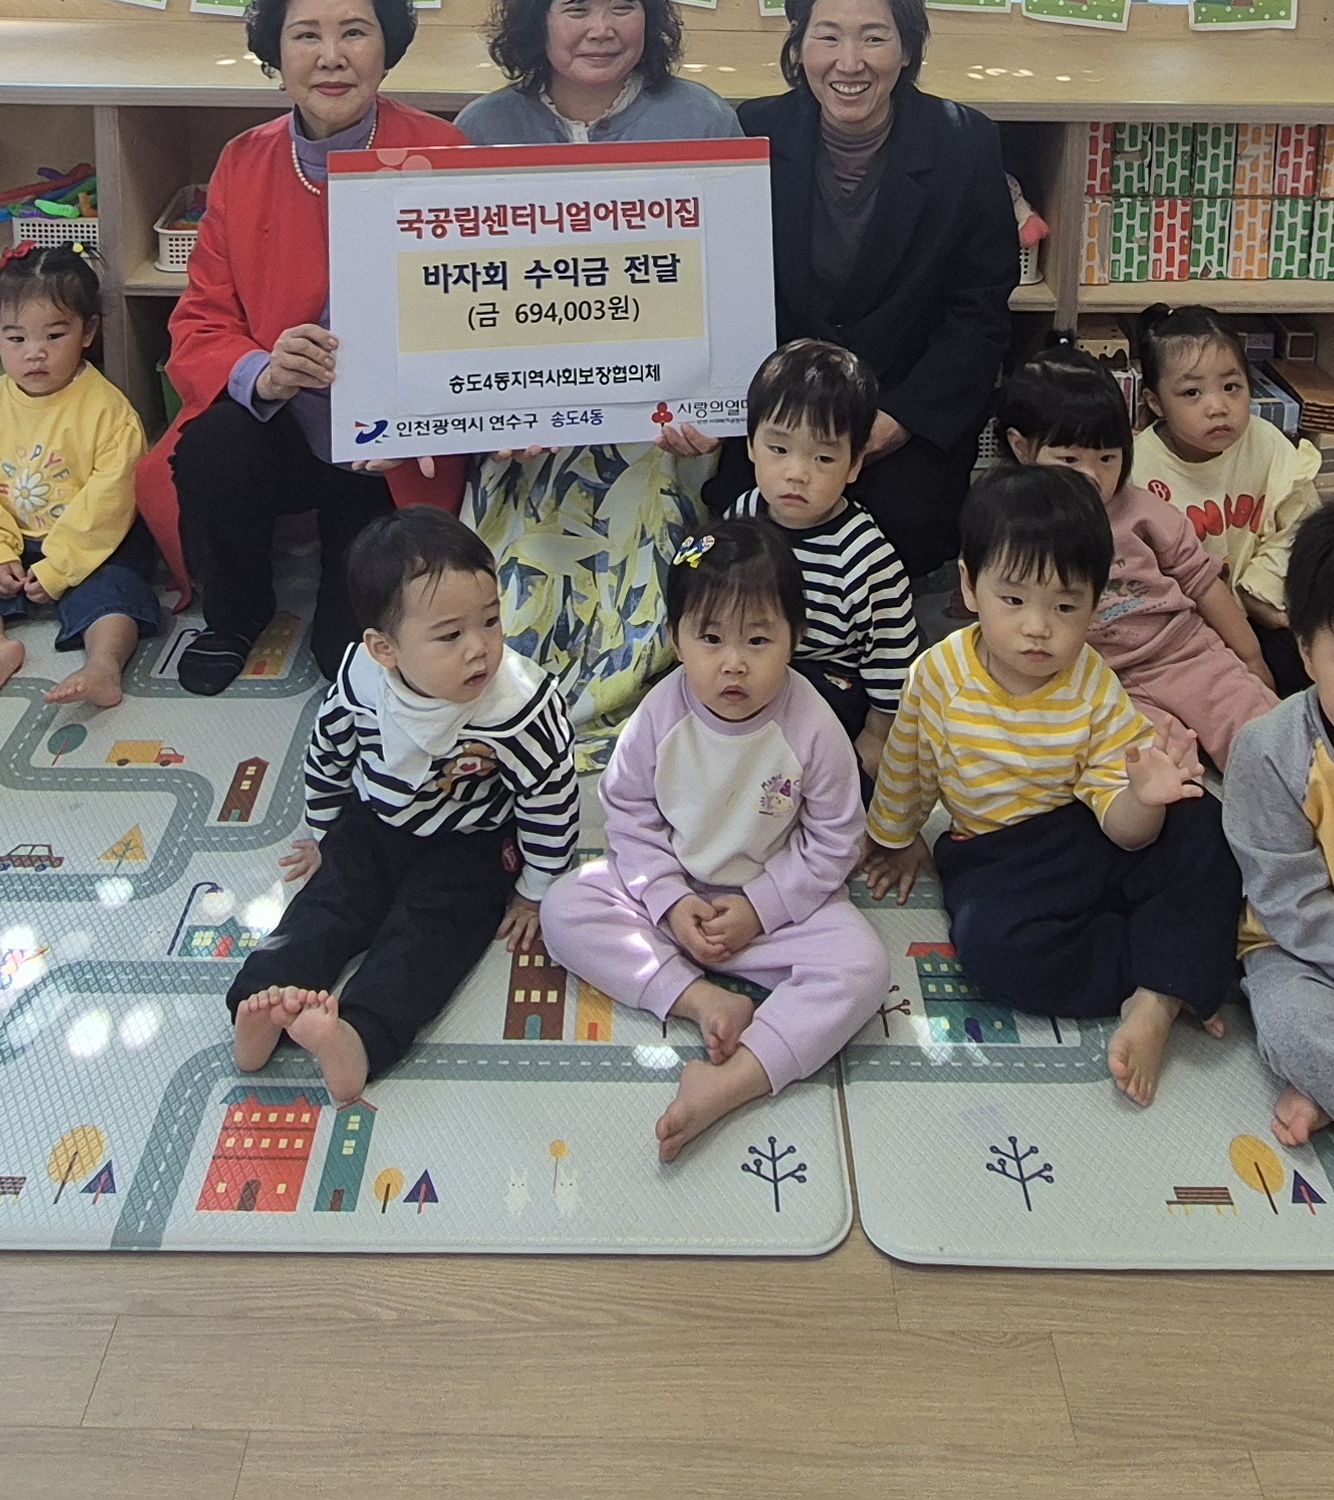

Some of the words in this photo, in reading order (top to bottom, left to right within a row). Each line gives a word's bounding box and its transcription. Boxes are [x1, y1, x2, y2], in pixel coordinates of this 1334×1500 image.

[396, 197, 700, 239] 국공립센터니얼어린이집
[422, 260, 508, 294] 바자회
[523, 256, 609, 289] 수익금
[623, 253, 681, 284] 전달
[468, 302, 500, 329] (금
[515, 295, 640, 325] 694,003원)
[449, 363, 661, 394] 송도4동지역사회보장협의체
[396, 416, 484, 438] 인천광역시
[489, 413, 539, 432] 연수구
[550, 409, 604, 428] 송도4동
